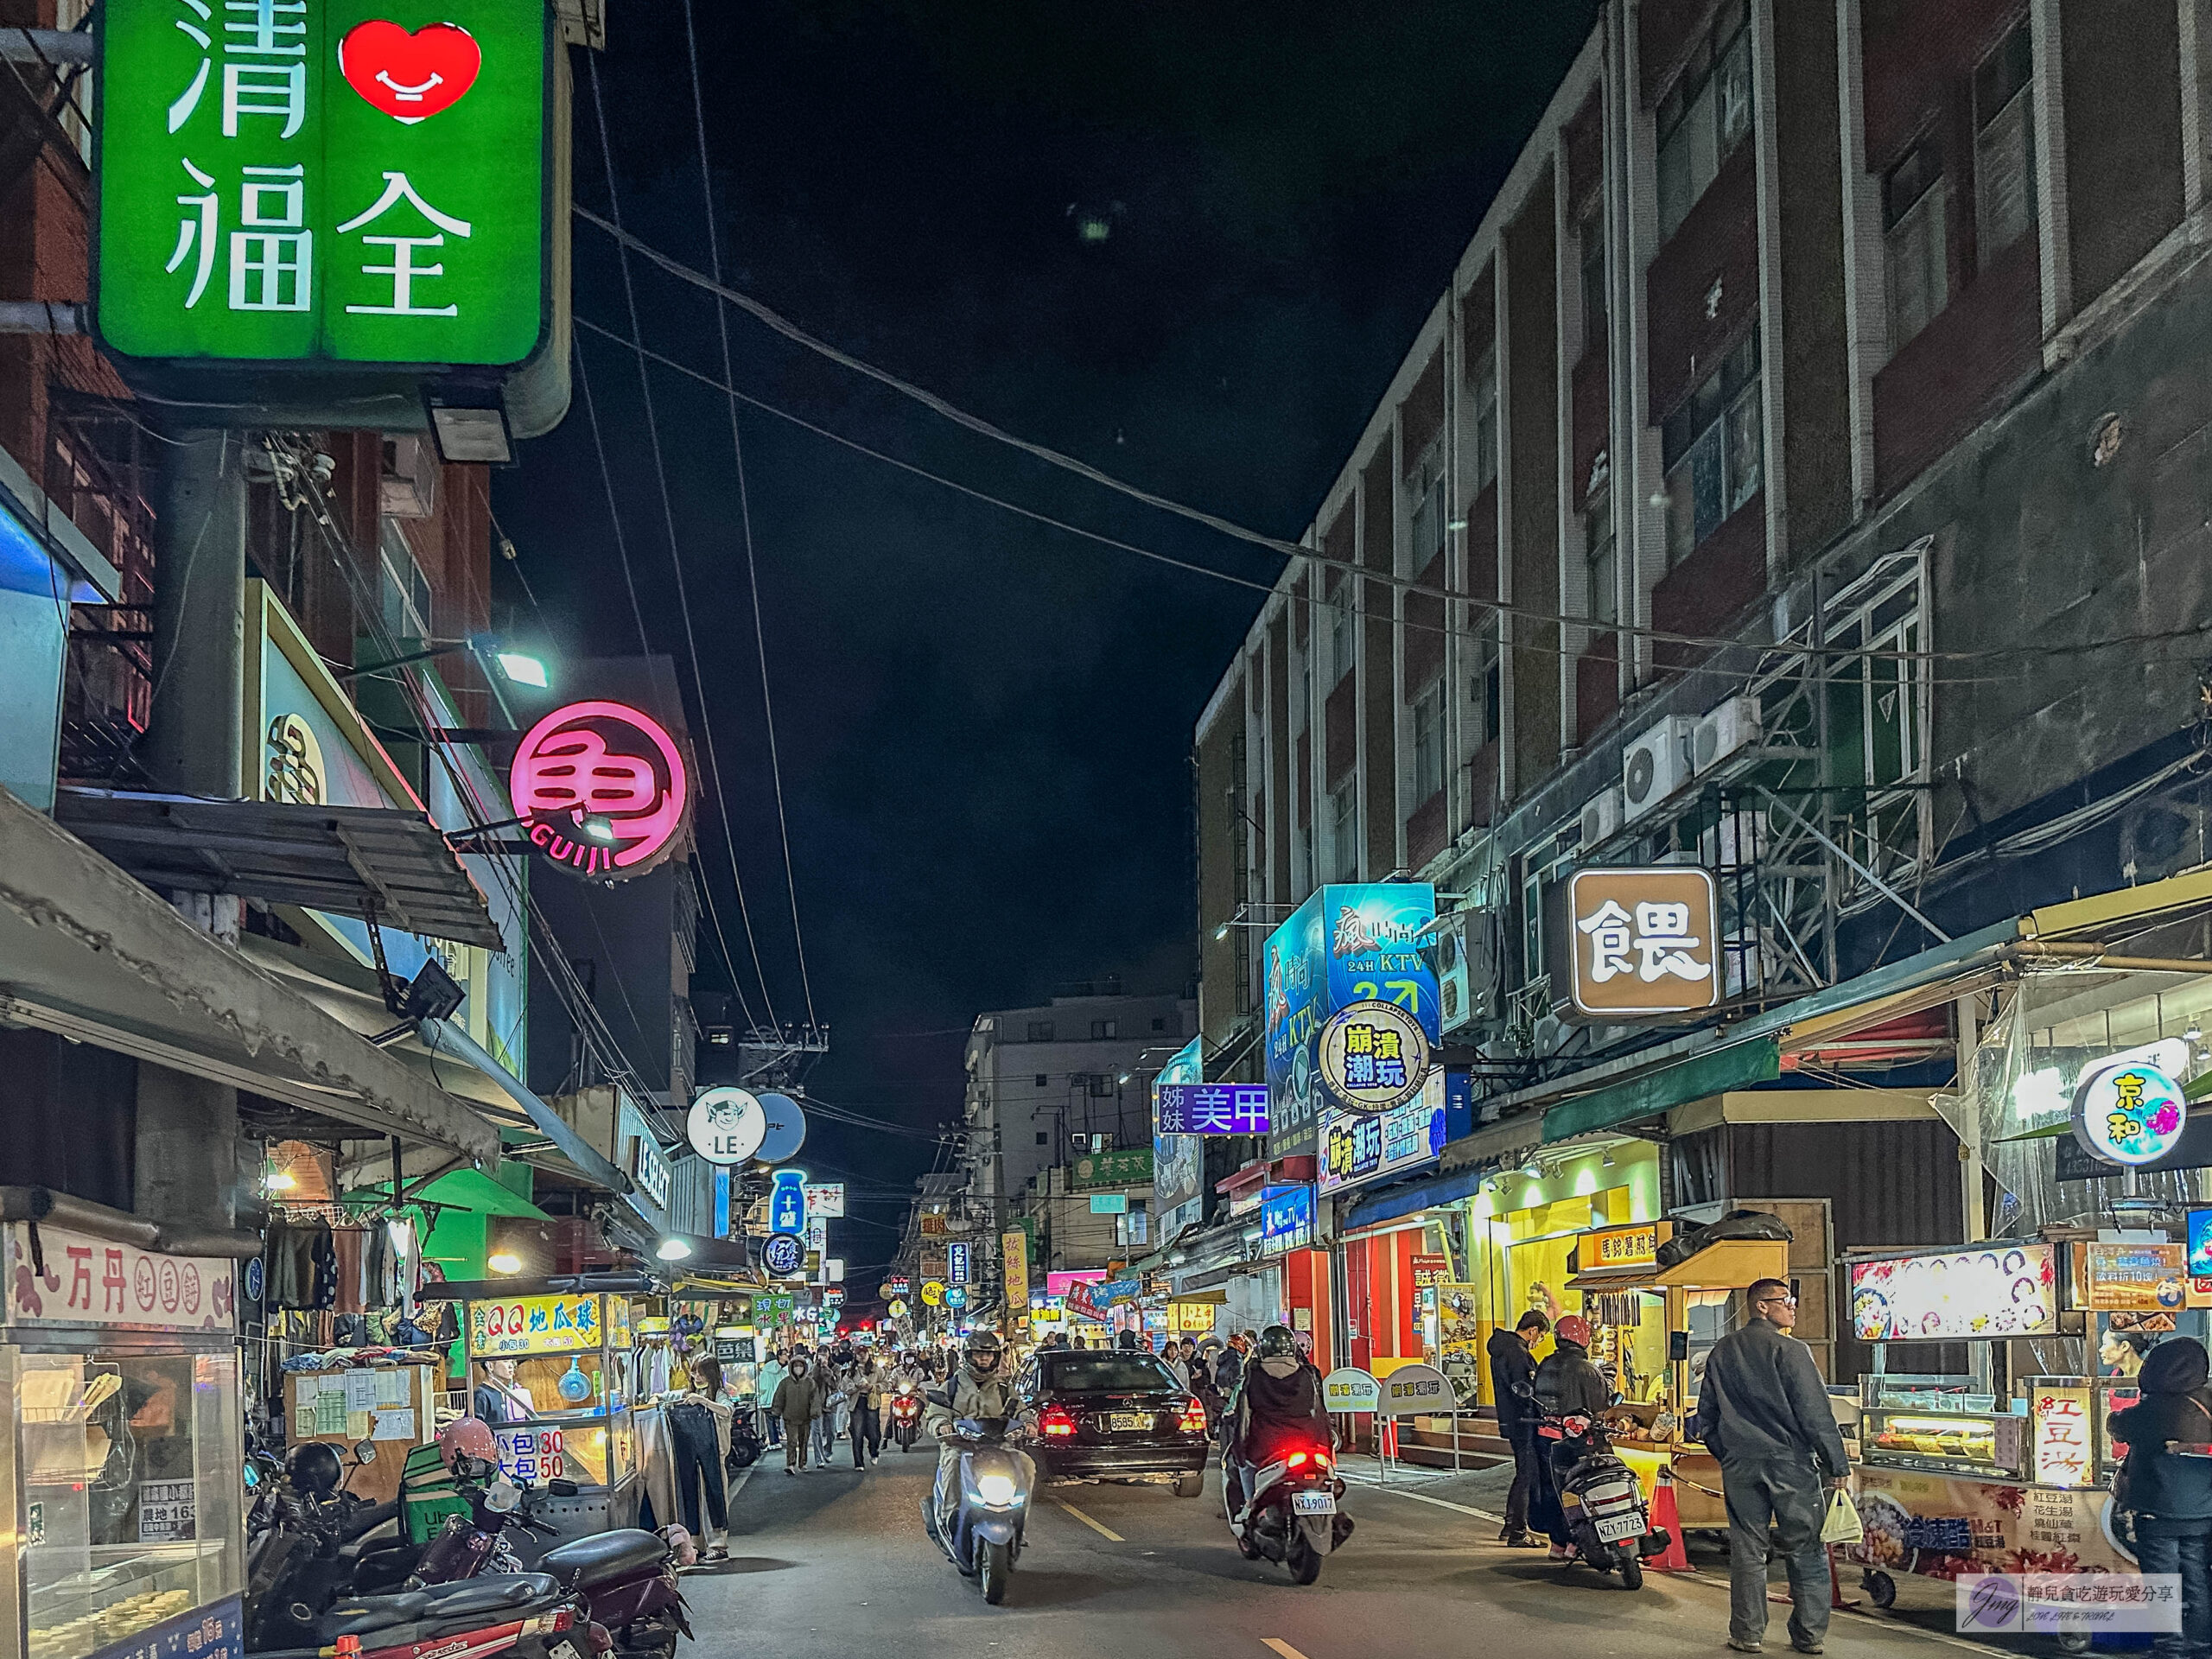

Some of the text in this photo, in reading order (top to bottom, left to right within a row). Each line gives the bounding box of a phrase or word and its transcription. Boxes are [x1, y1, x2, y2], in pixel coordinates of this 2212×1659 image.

[166, 0, 314, 313] 清福
[335, 170, 473, 317] 全
[530, 823, 612, 874] GUIJI
[1347, 953, 1425, 973] 24H KTV
[1288, 995, 1319, 1047] KTV
[1371, 1001, 1406, 1018] COLLAPSE
[1346, 1025, 1401, 1059] 崩潰
[1345, 1055, 1406, 1087] 潮玩
[1162, 1086, 1185, 1132] 姊妹
[1192, 1087, 1269, 1132] 美甲
[2107, 1072, 2147, 1144] 京和
[714, 1135, 738, 1154] LE
[1329, 1118, 1381, 1175] 崩潰潮玩
[67, 1245, 127, 1314] 万丹
[1005, 1236, 1024, 1306] 拔絲地瓜
[474, 1306, 487, 1351] 全素
[757, 1311, 791, 1327] 水果
[540, 1430, 563, 1454] 30
[540, 1455, 563, 1479] 50
[2033, 1491, 2074, 1504] 紅豆湯
[2033, 1504, 2074, 1517] 花生湯
[1599, 1517, 1643, 1538] NZY-7723
